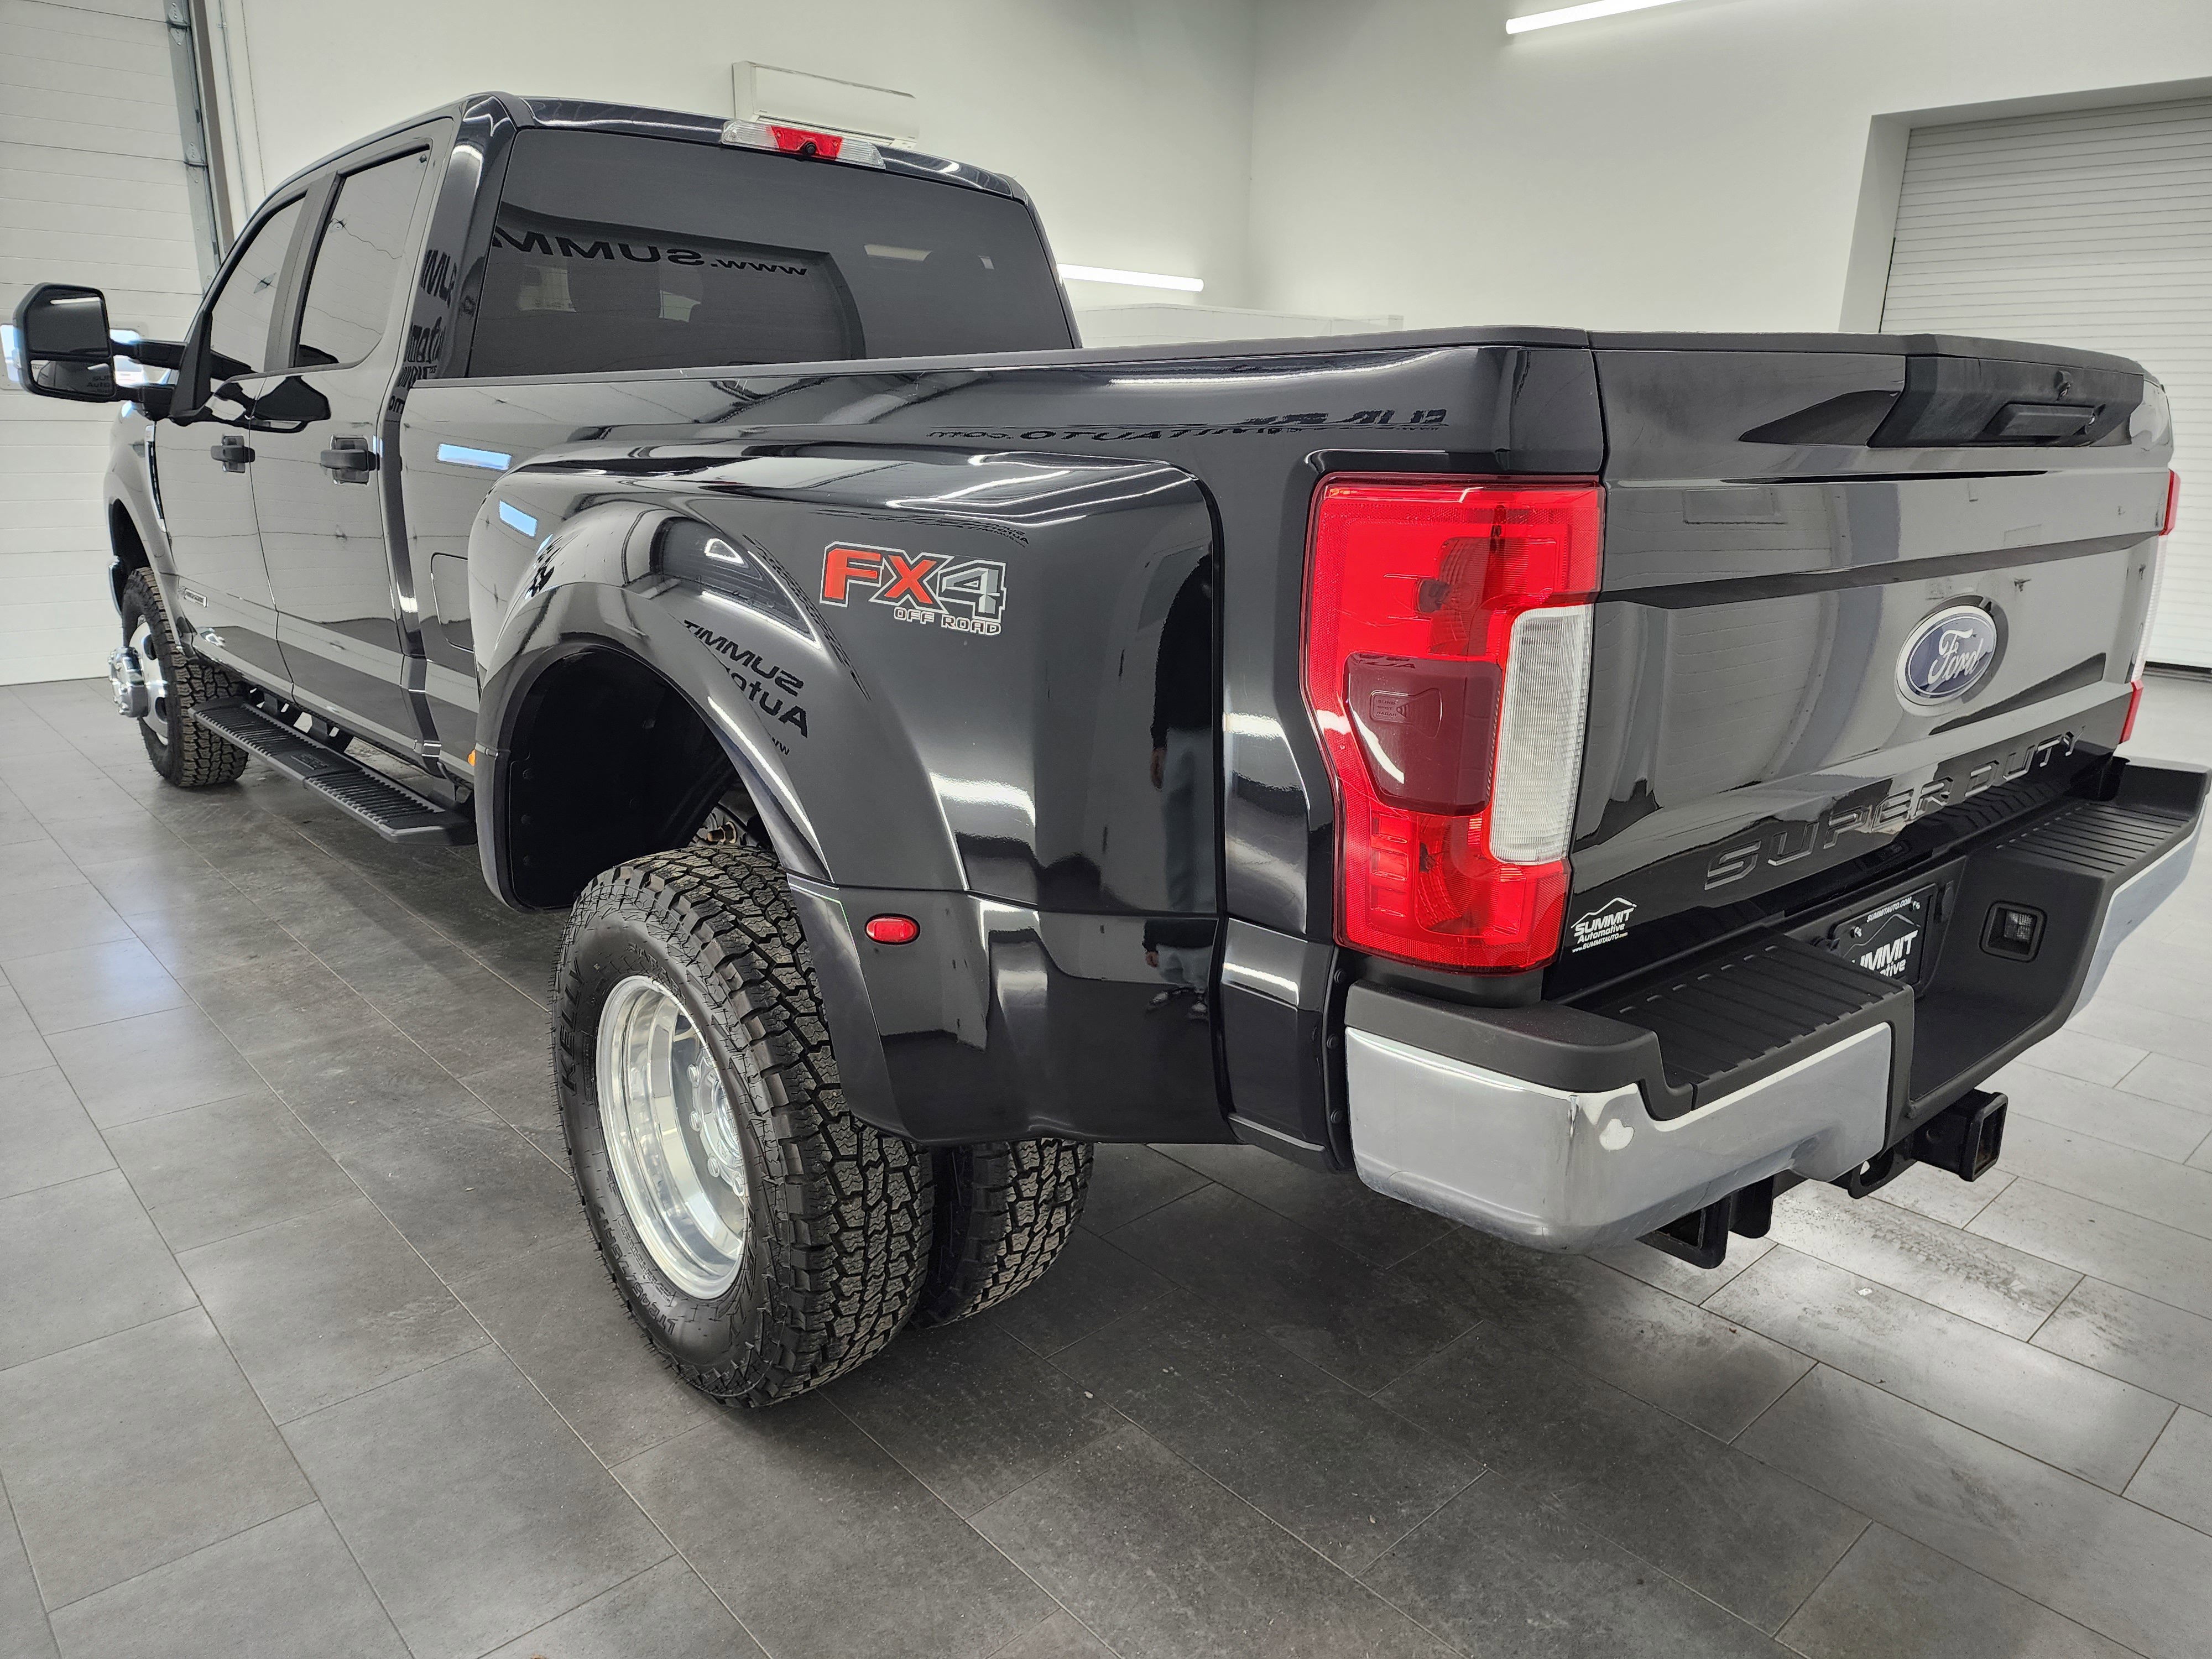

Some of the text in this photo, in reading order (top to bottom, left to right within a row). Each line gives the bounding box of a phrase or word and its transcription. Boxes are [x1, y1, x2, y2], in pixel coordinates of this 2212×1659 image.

[820, 541, 1007, 623] FX4
[894, 607, 1002, 636] OFF ROAD
[1927, 628, 1984, 685] Ford
[1704, 725, 2086, 891] SUPER DUTY
[1574, 907, 1635, 937] SUMMIT
[1866, 896, 1912, 923] SUMMITAUTO.COM
[1572, 932, 1628, 953] www.SUMMITAUTO.com
[1577, 923, 1625, 944] Automotive
[1851, 930, 1918, 971] MMIT
